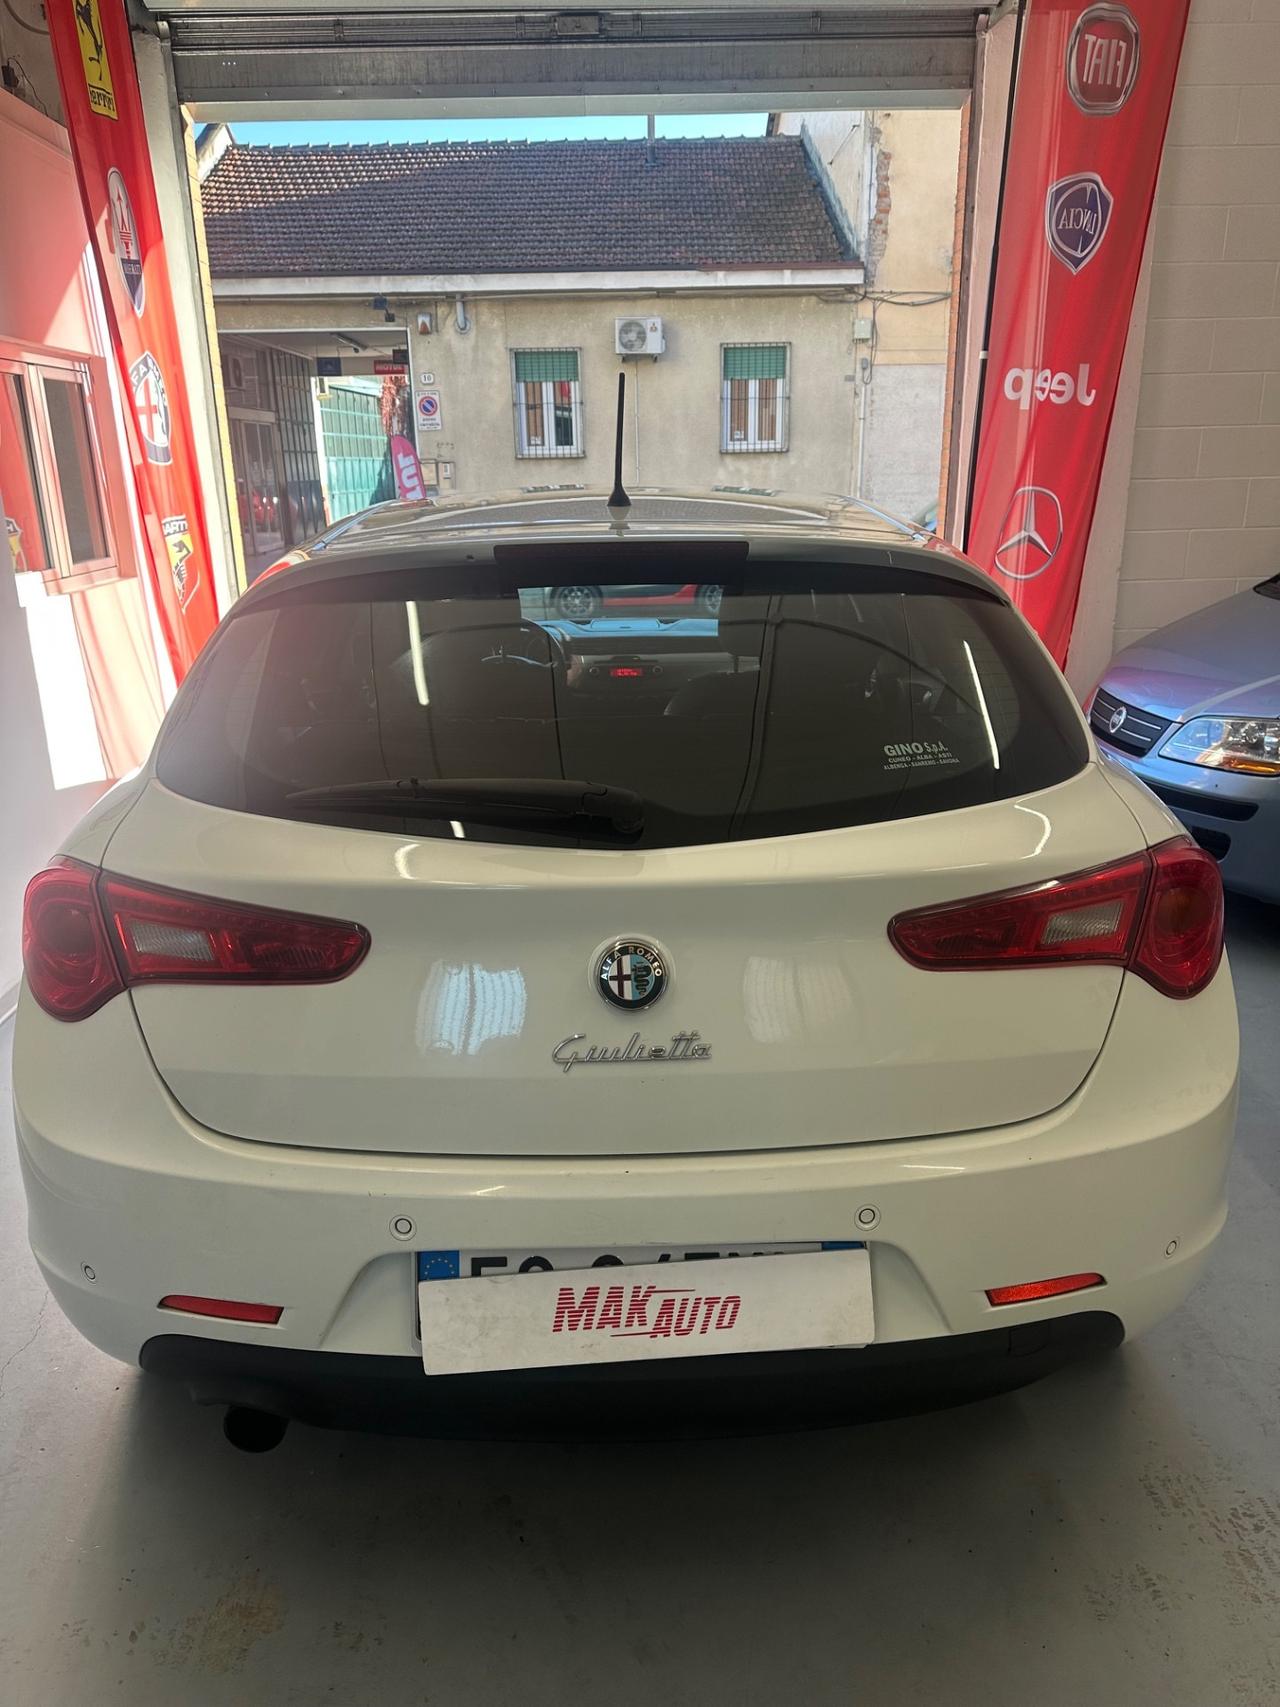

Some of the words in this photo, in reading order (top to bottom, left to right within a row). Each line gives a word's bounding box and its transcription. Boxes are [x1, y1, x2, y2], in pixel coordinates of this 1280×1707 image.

[884, 742, 923, 757] GINO
[601, 950, 621, 980] ALFA
[628, 946, 662, 977] ROMEO
[552, 1030, 712, 1073] Giulietta
[552, 1285, 656, 1333] MAK
[650, 1295, 742, 1339] AUTO
